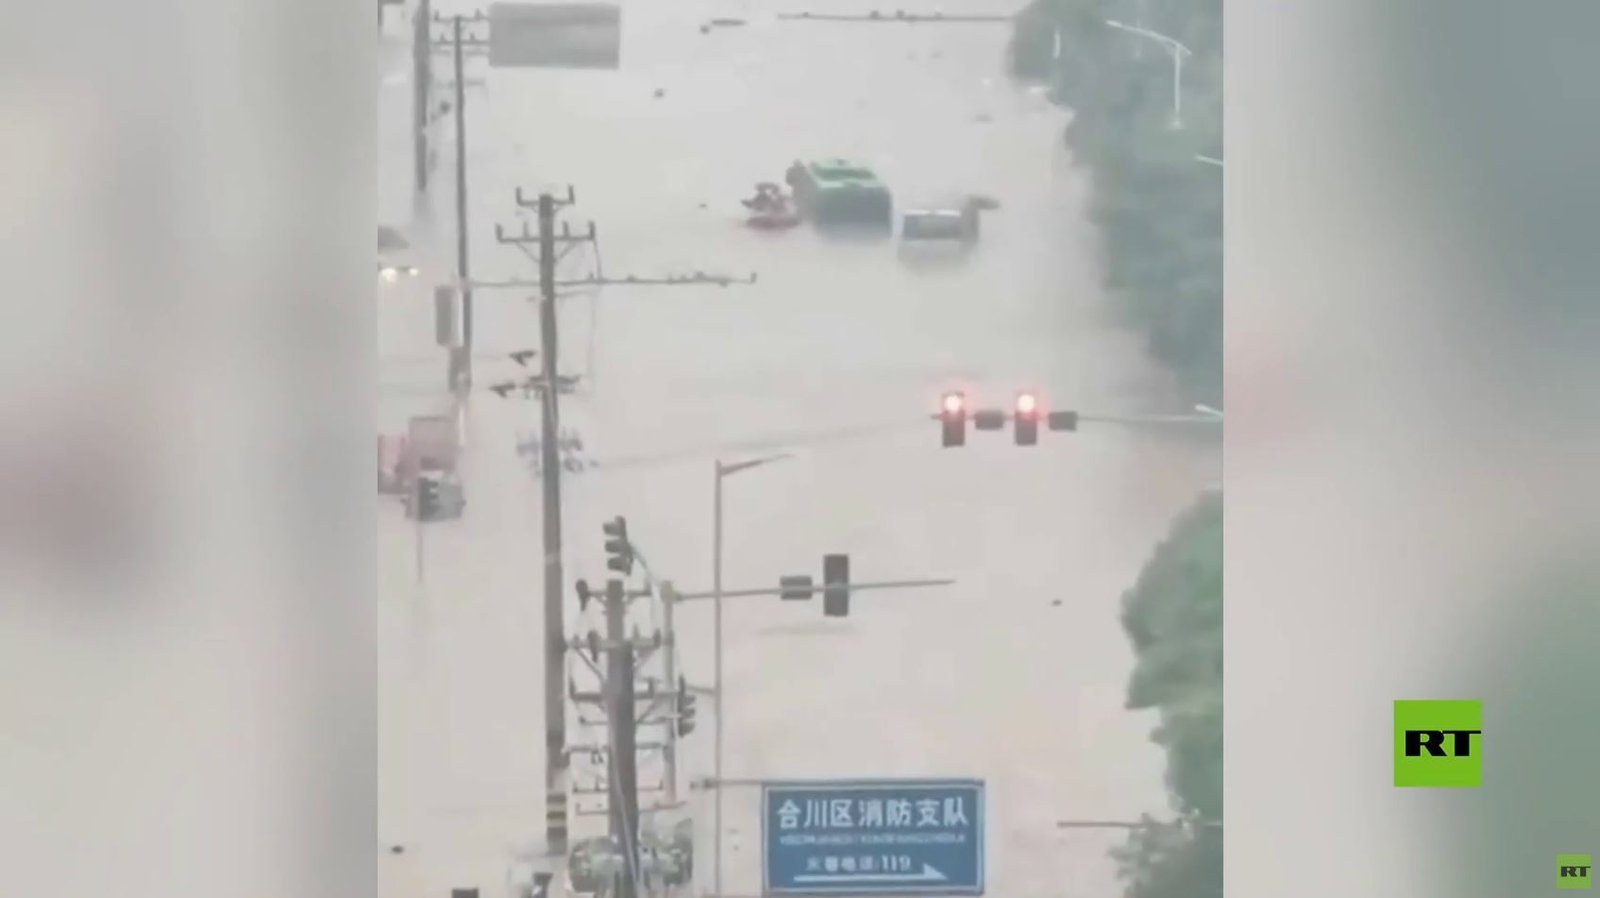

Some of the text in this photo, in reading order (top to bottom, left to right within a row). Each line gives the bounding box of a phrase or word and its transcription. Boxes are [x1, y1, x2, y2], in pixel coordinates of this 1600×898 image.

[778, 797, 968, 829] 合川区消防支队
